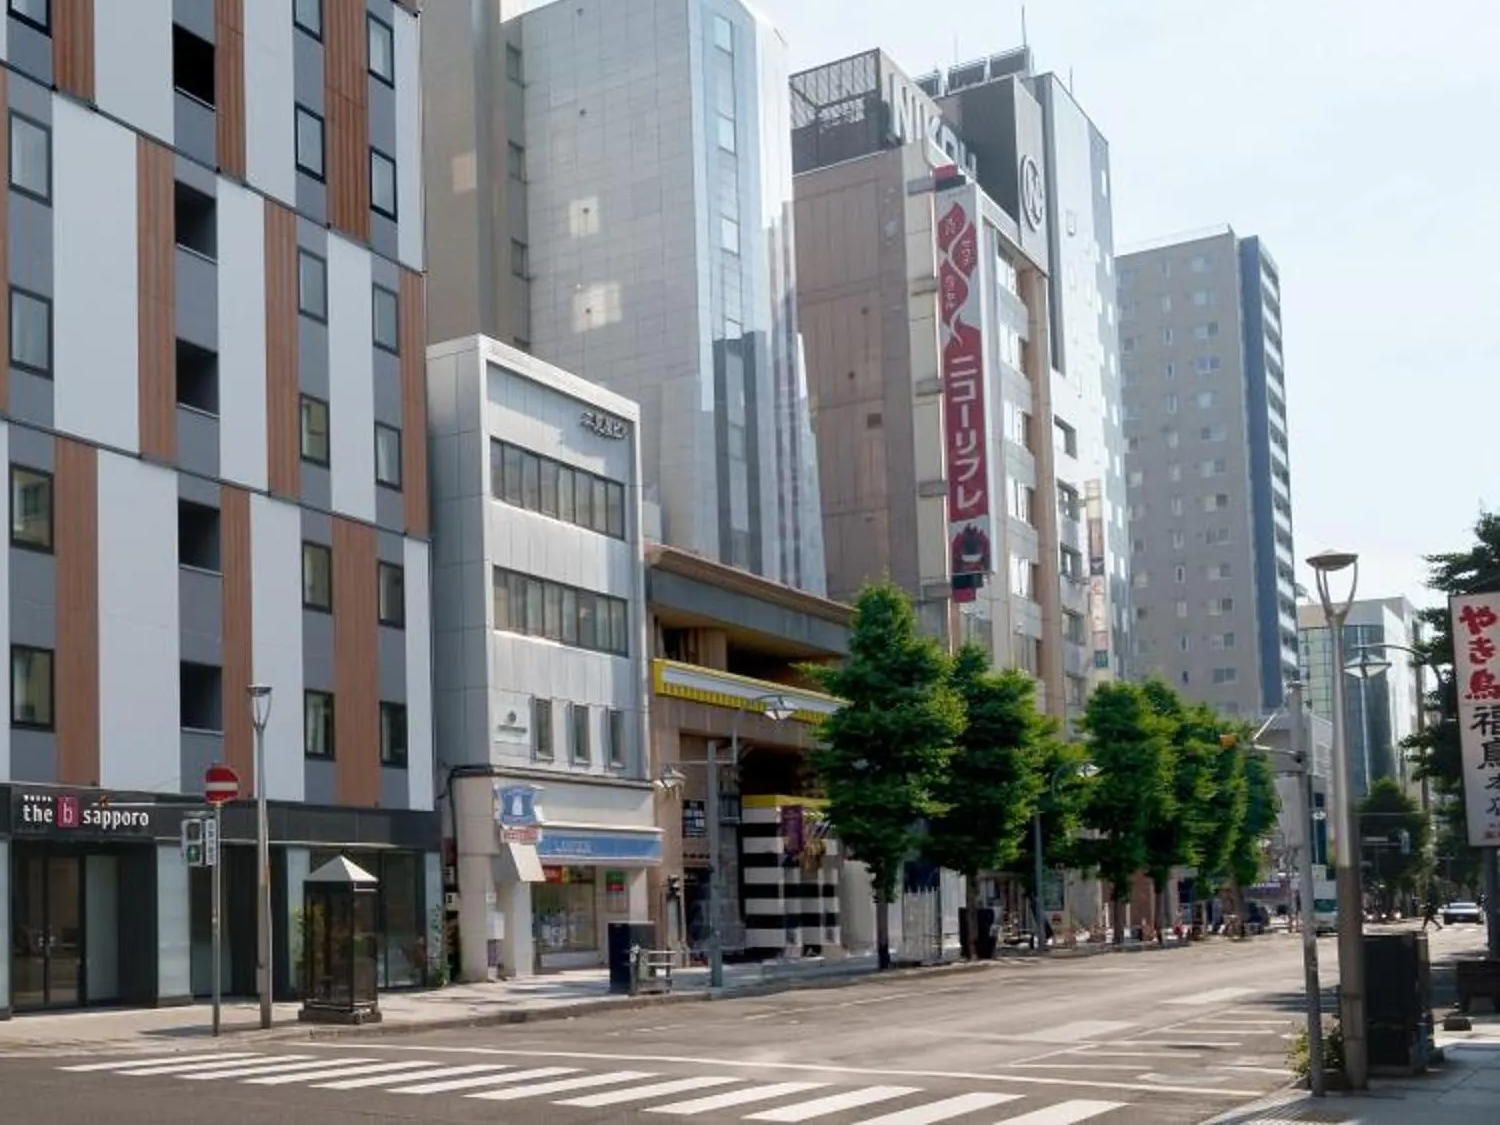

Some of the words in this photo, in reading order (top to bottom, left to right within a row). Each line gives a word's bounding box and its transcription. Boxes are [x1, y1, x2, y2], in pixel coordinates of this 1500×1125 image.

[950, 354, 982, 509] ニコーリフレ
[1458, 604, 1500, 699] やき鳥
[23, 804, 53, 823] the
[63, 802, 73, 824] b
[83, 808, 149, 830] sapporo
